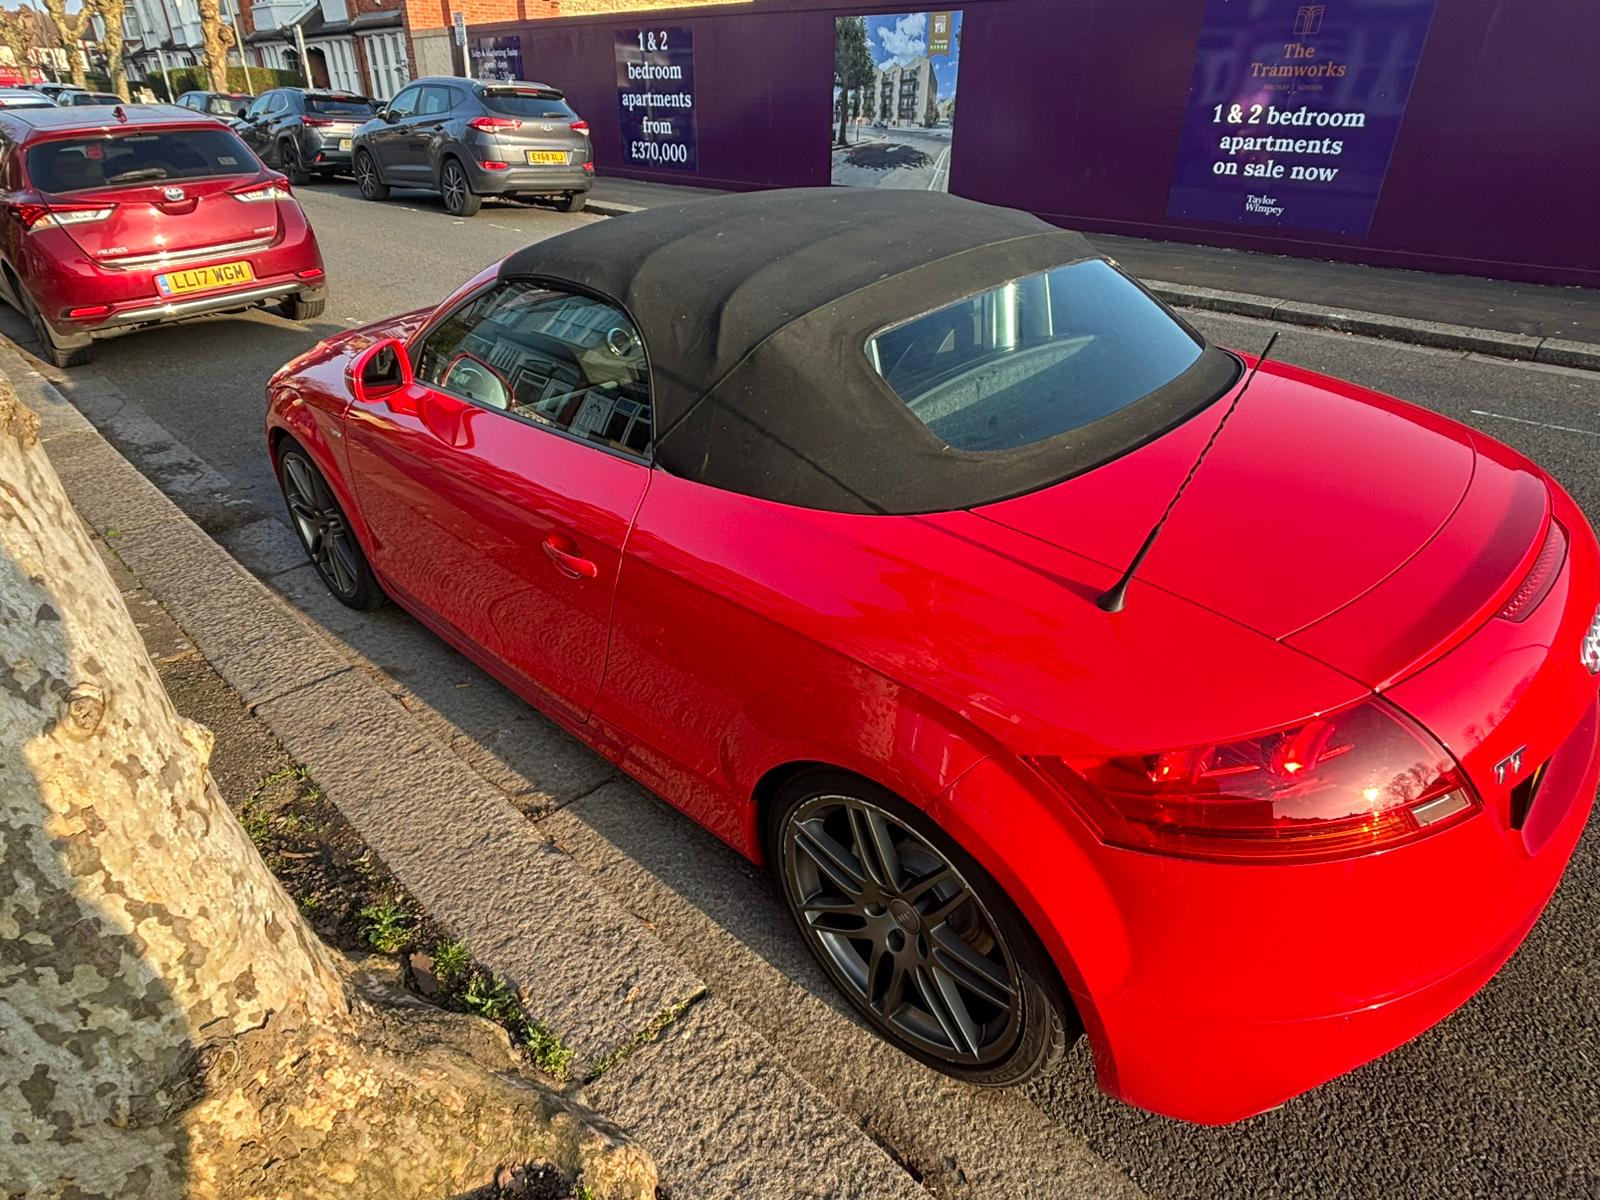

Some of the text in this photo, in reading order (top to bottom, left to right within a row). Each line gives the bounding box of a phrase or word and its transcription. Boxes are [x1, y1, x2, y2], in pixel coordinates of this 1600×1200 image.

[638, 31, 668, 51] 1 & 2
[1283, 43, 1316, 58] The
[627, 61, 682, 79] bedroom
[1251, 61, 1347, 77] Tramworks
[622, 92, 692, 111] apartments
[1213, 104, 1365, 127] 1 & 2 bedroom
[642, 116, 672, 135] from
[631, 141, 687, 164] £370,000
[1219, 135, 1344, 155] apartments
[1213, 160, 1339, 182] on sale now
[1246, 194, 1277, 206] Taylor
[1245, 203, 1285, 217] Wimpey
[172, 264, 245, 290] LL17 WGM
[1493, 744, 1527, 785] TT
